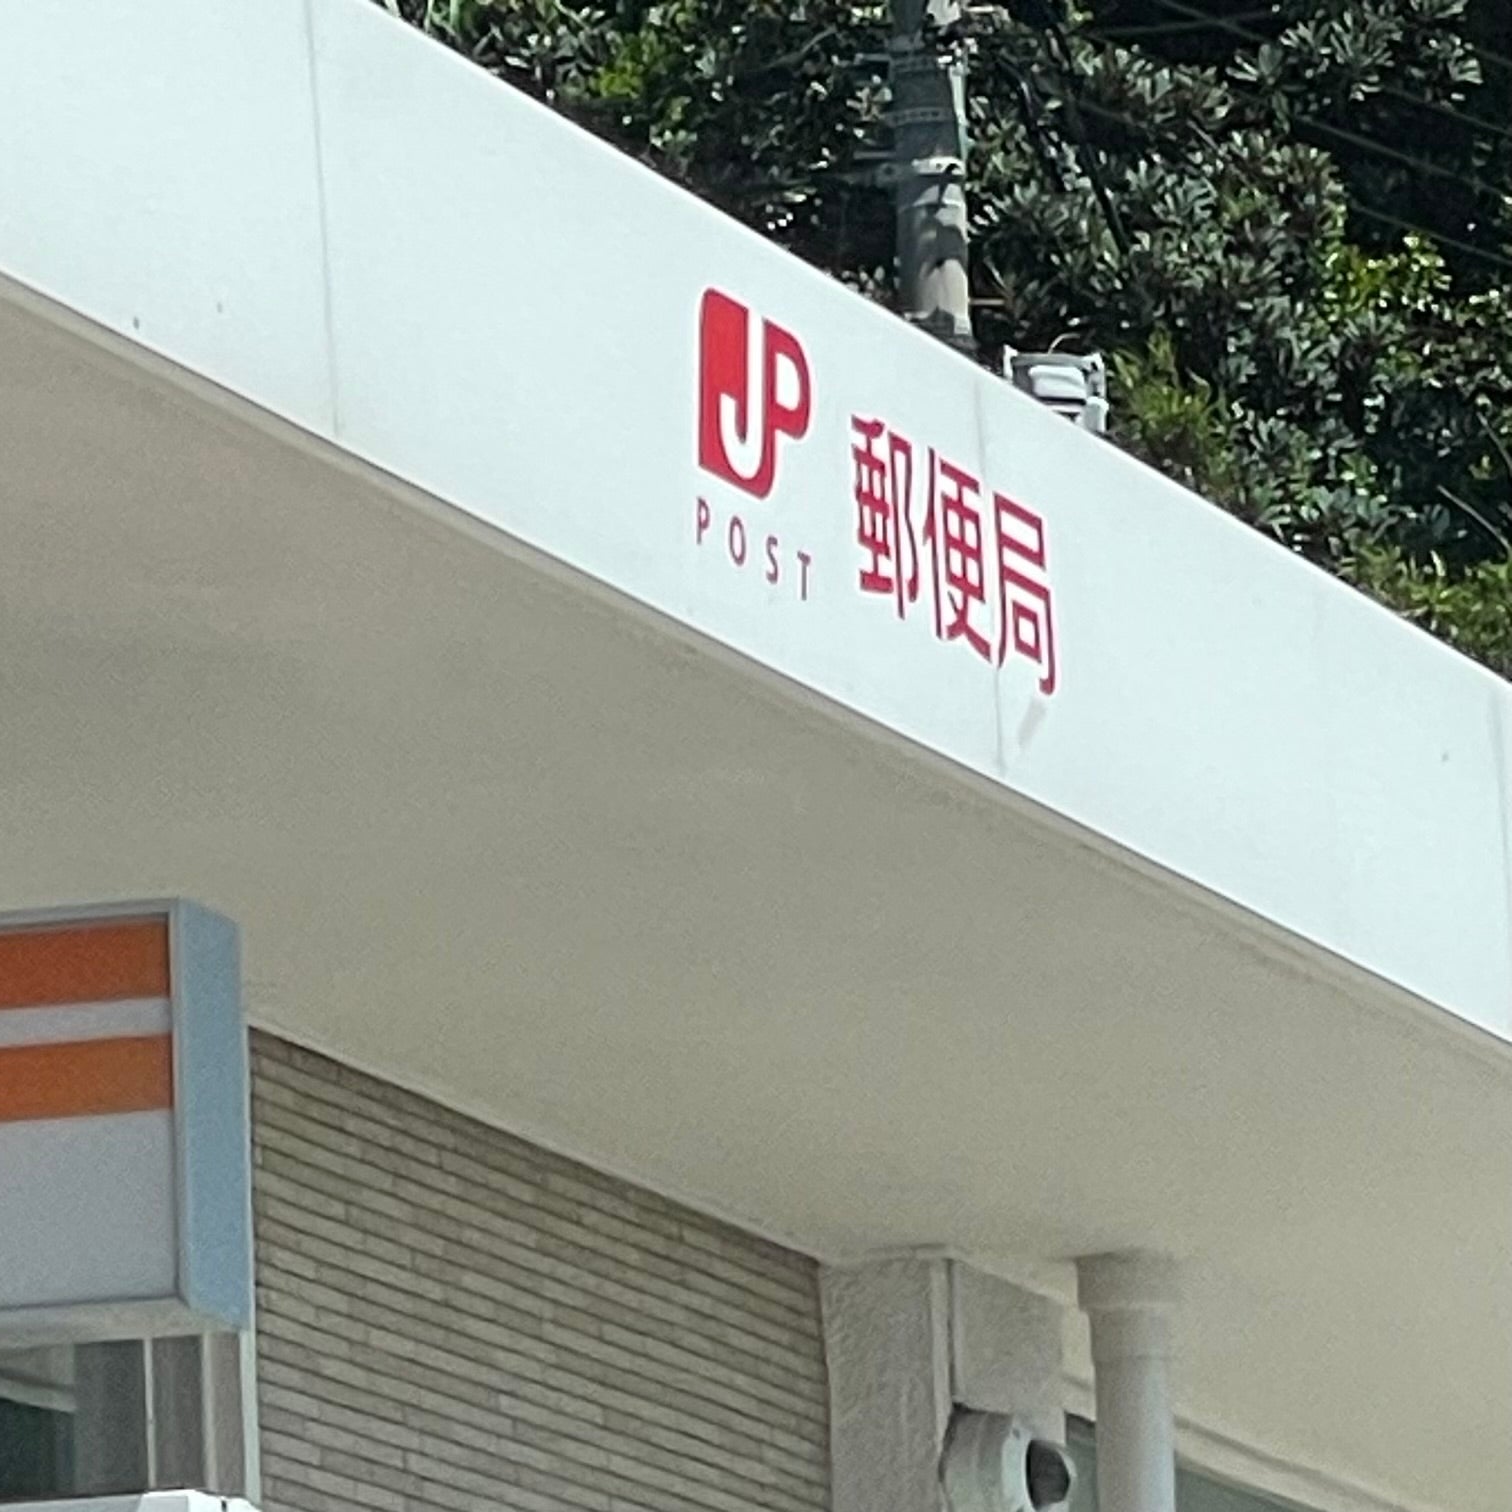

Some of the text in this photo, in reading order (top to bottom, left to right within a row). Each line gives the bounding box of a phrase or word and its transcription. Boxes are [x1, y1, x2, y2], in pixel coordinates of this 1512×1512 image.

[696, 497, 811, 600] POST
[850, 414, 1056, 695] 郵便局
